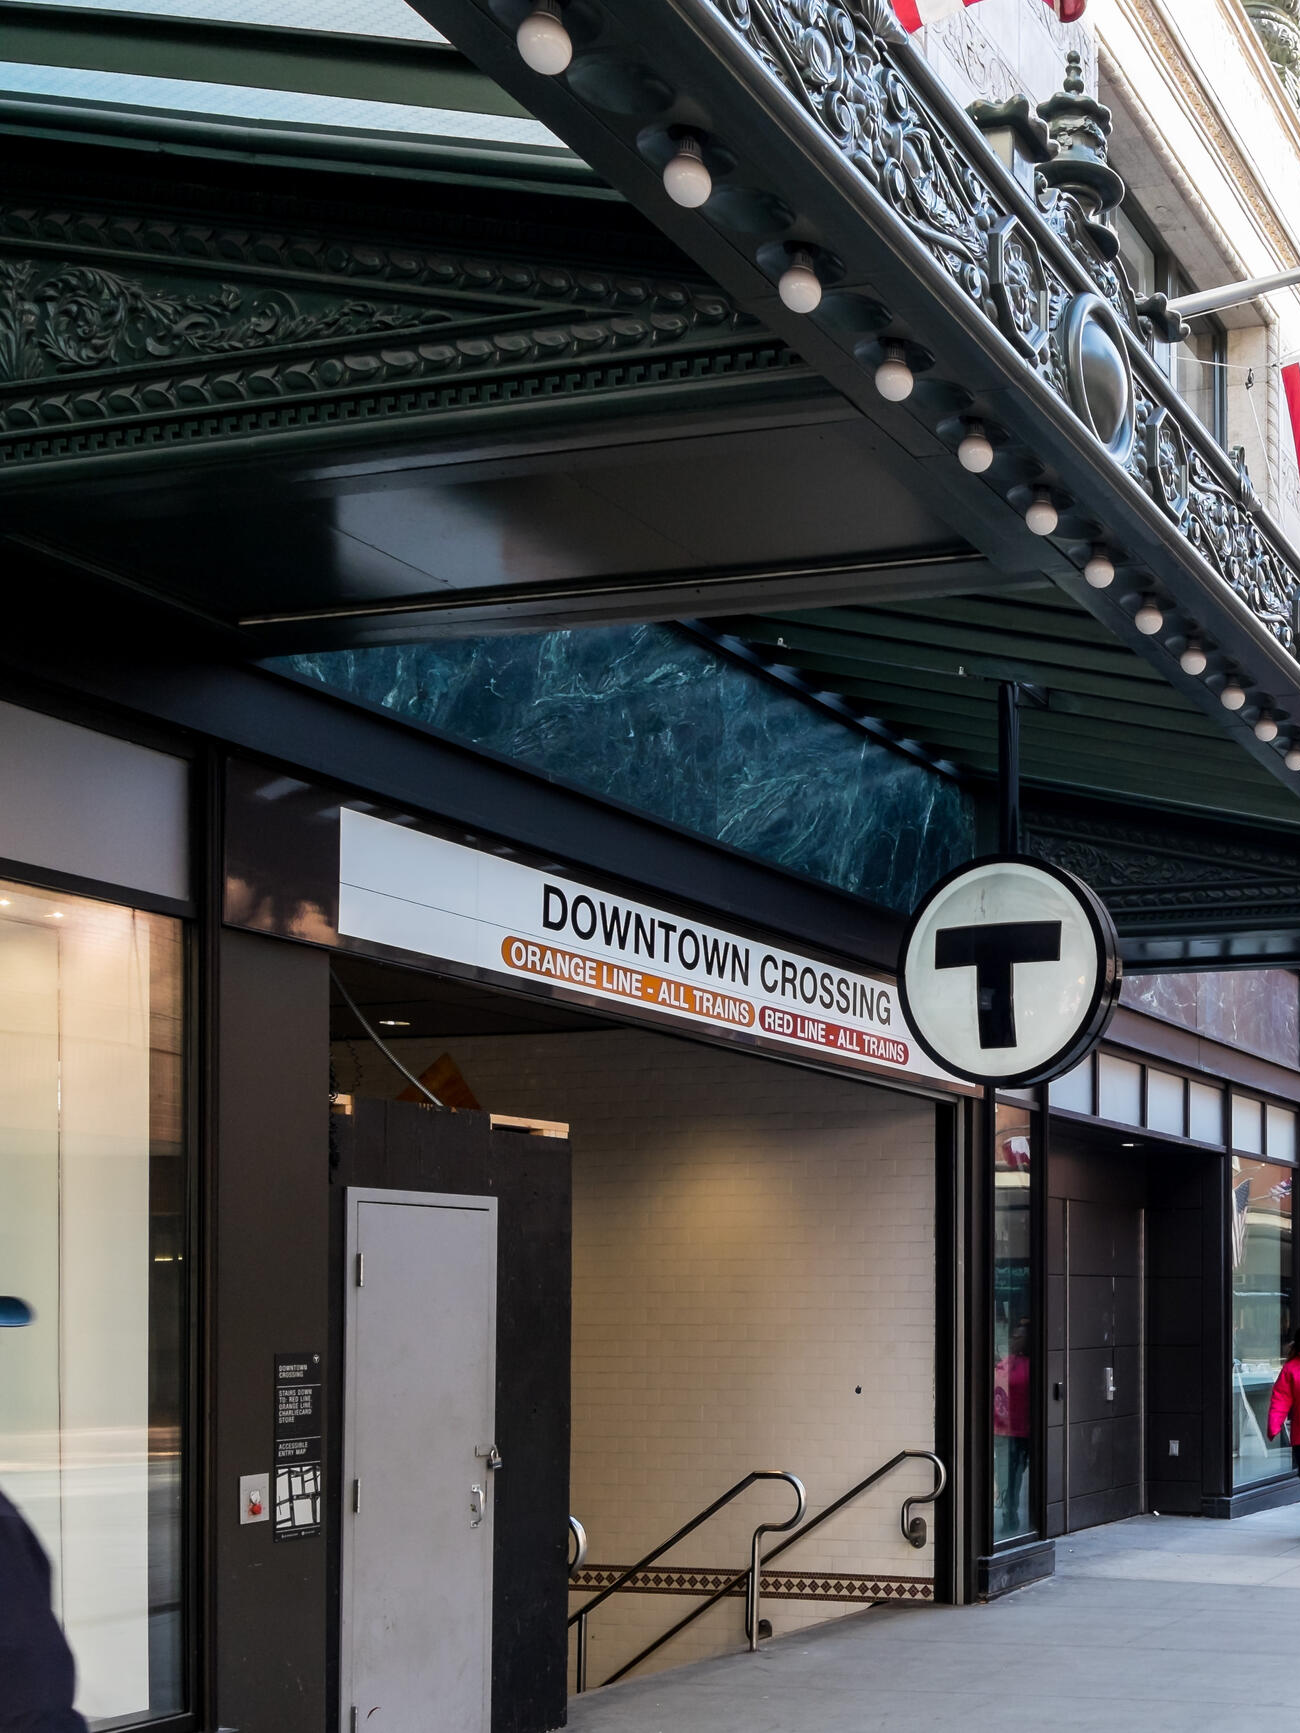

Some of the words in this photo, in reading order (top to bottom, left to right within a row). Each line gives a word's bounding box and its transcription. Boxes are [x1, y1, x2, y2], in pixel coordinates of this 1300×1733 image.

[542, 883, 750, 986] DOWNTOWN
[760, 954, 891, 1026] CROSSING
[510, 941, 597, 985] ORANGE
[602, 965, 643, 997] LINE
[658, 981, 689, 1009] ALL
[693, 990, 750, 1024] TRAINS
[935, 920, 1062, 1049] T
[765, 1010, 794, 1035] RED
[797, 1019, 826, 1043] LINE
[837, 1029, 860, 1052] ALL
[863, 1035, 905, 1063] TRAINS
[279, 1364, 308, 1372] DOWNTOWN
[278, 1441, 308, 1450] ACCESSIBLE
[278, 1449, 294, 1457] ENTRY
